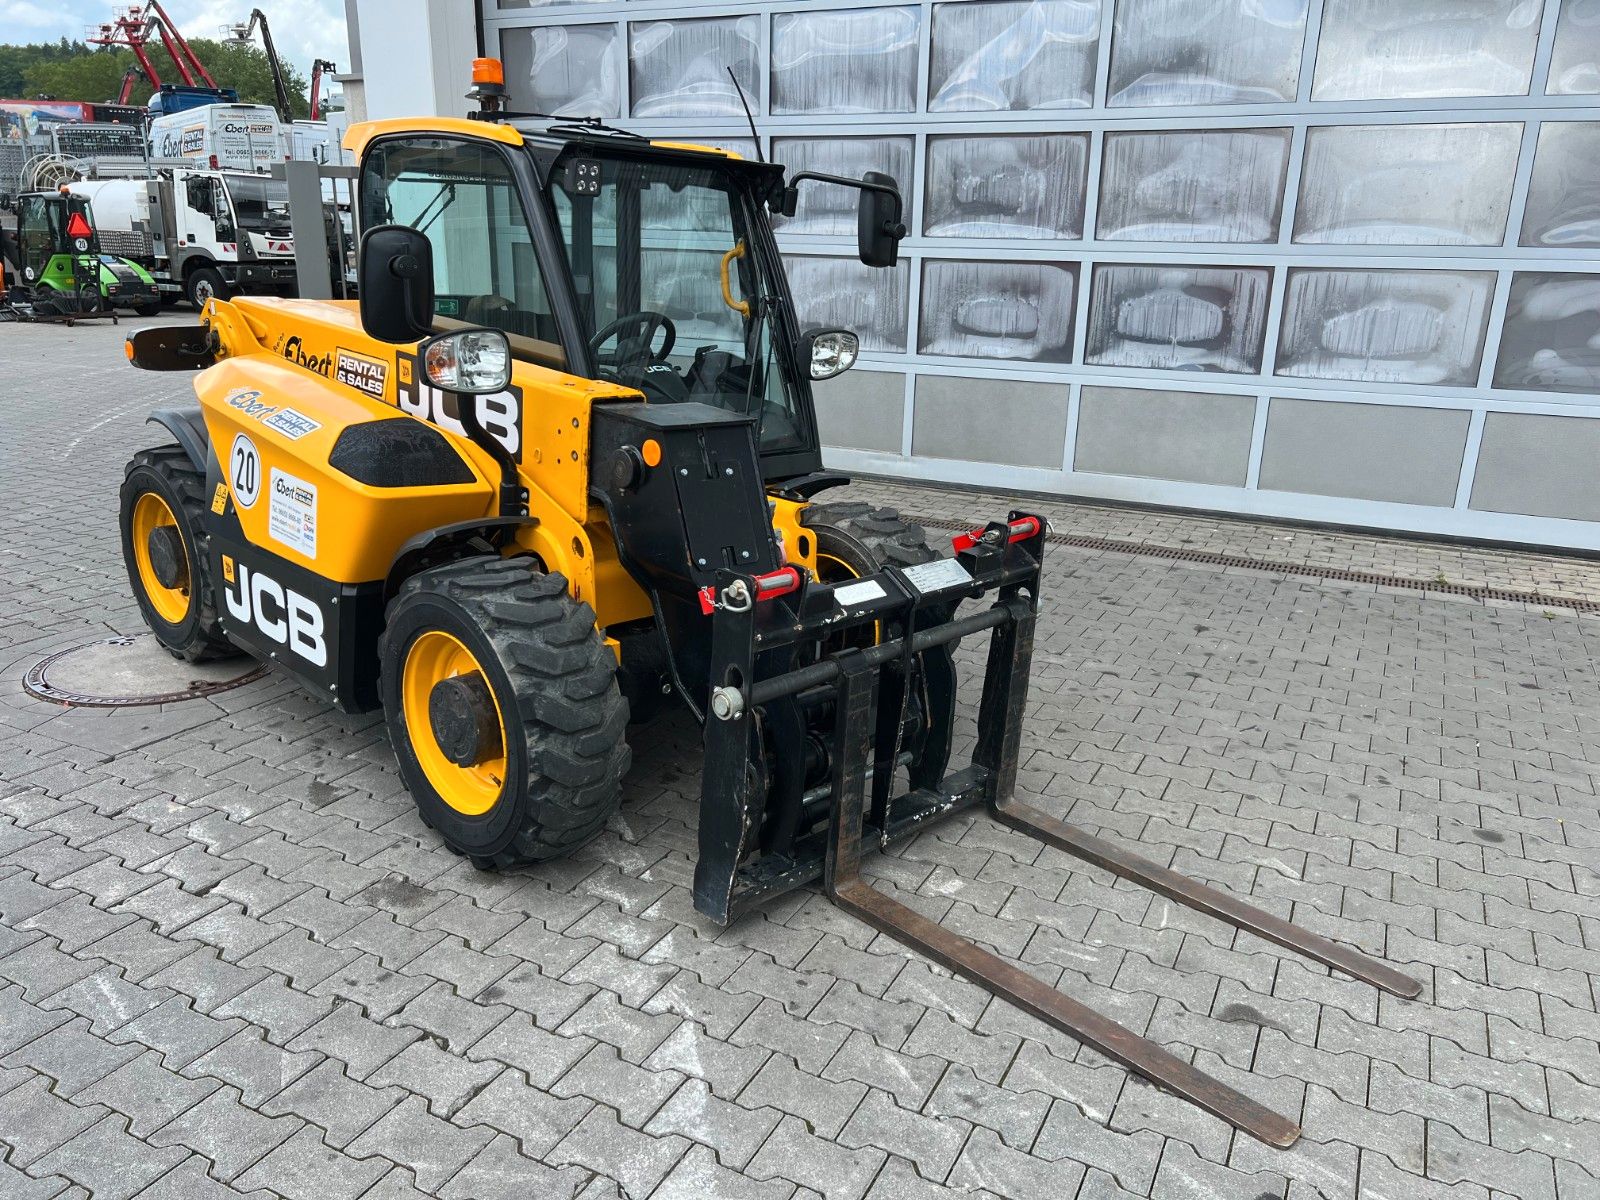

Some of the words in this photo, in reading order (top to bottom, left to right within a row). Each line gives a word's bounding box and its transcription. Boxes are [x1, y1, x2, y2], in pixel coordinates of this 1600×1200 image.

[225, 123, 249, 133] Ebert
[163, 133, 183, 157] Ebert
[78, 241, 86, 249] 20
[284, 335, 332, 379] Ebert
[339, 355, 384, 380] RENTAL
[347, 374, 383, 394] SALES
[229, 391, 278, 419] Ebert
[275, 418, 306, 436] SALES
[279, 410, 314, 430] RENTAL
[235, 447, 255, 495] 20
[276, 478, 295, 499] Ebert
[225, 563, 327, 667] JCB
